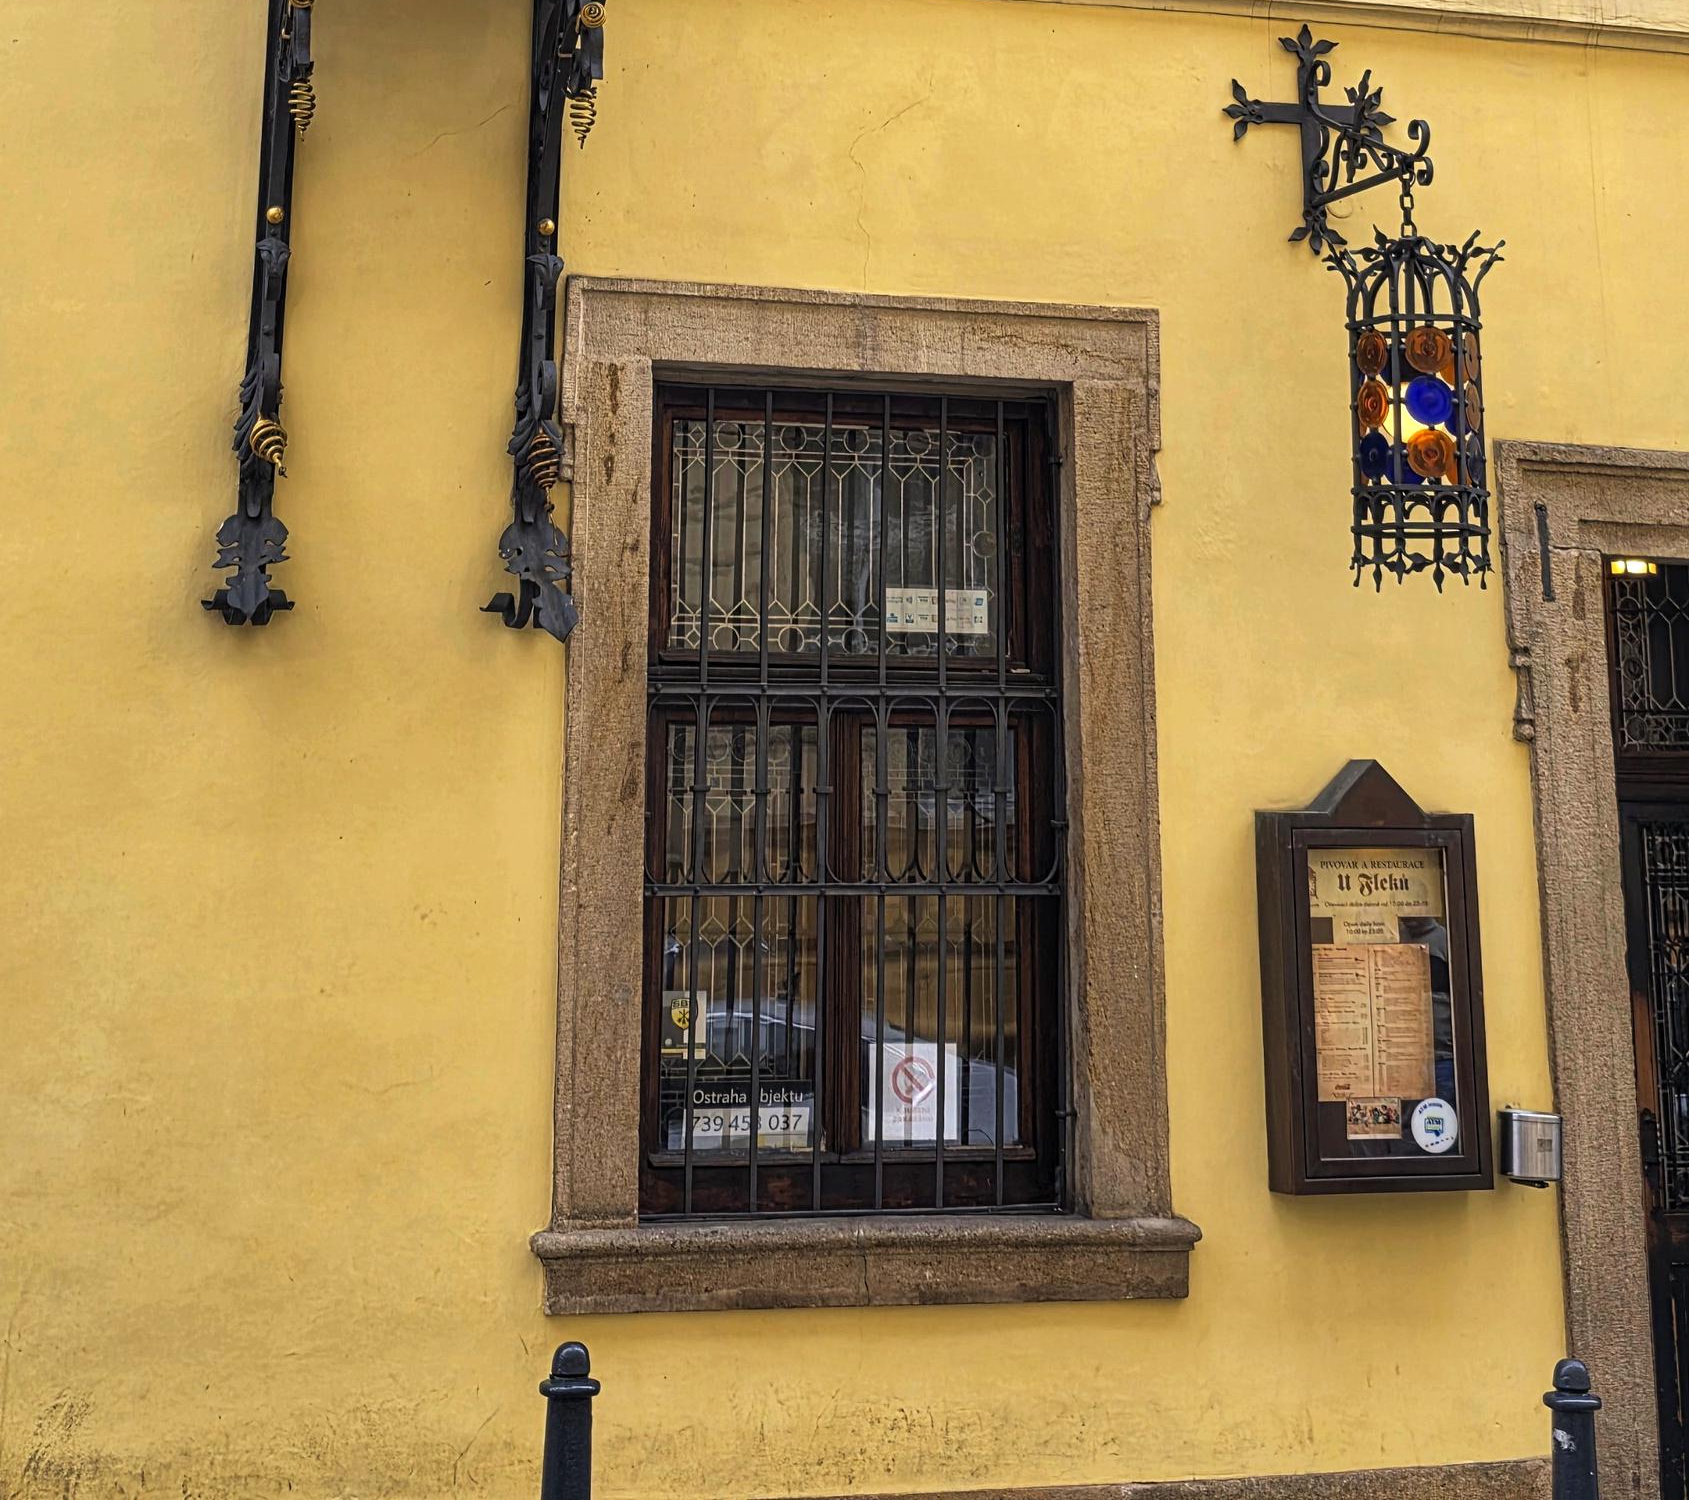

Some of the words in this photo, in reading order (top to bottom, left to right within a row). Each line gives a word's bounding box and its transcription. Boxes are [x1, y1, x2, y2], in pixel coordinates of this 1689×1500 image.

[1320, 860, 1358, 869] PIVOVAR
[1361, 860, 1368, 869] A
[1370, 860, 1425, 869] RESTAURACE
[1338, 873, 1351, 891] U
[693, 1088, 747, 1104] Ostraha
[759, 1087, 803, 1107] bjektu
[692, 1115, 724, 1132] 739
[768, 1114, 802, 1131] 037
